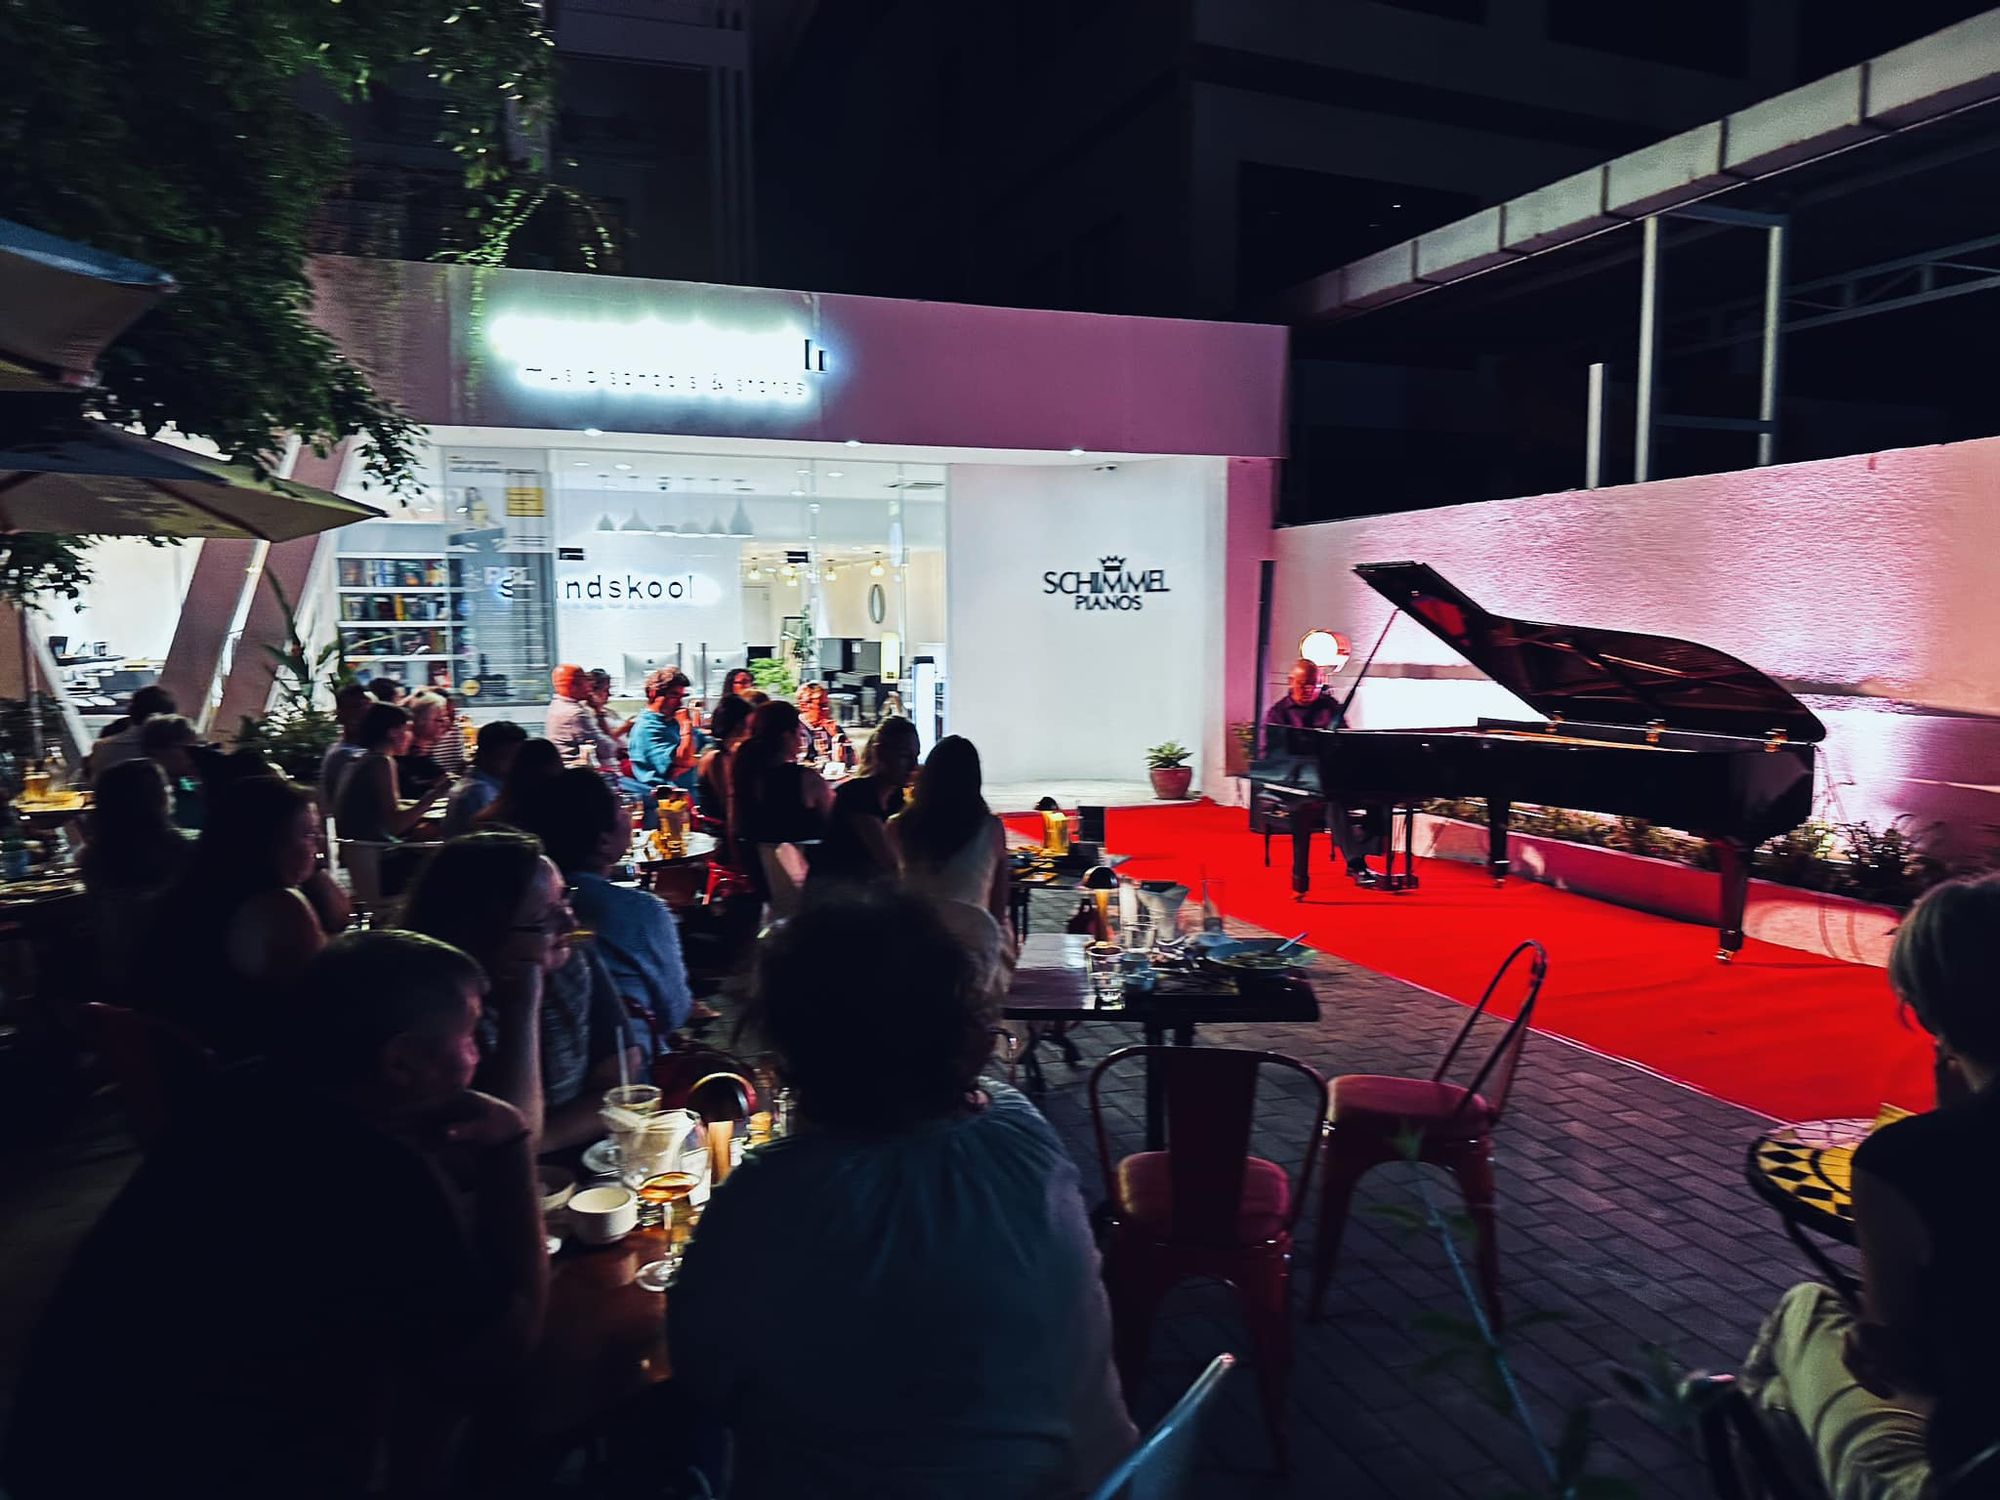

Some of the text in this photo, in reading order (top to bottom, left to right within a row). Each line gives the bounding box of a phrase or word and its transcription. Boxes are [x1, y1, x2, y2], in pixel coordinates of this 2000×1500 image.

[498, 574, 693, 599] sndskool
[1043, 569, 1171, 594] SCHIMMEL
[1075, 595, 1143, 611] PIANOS
